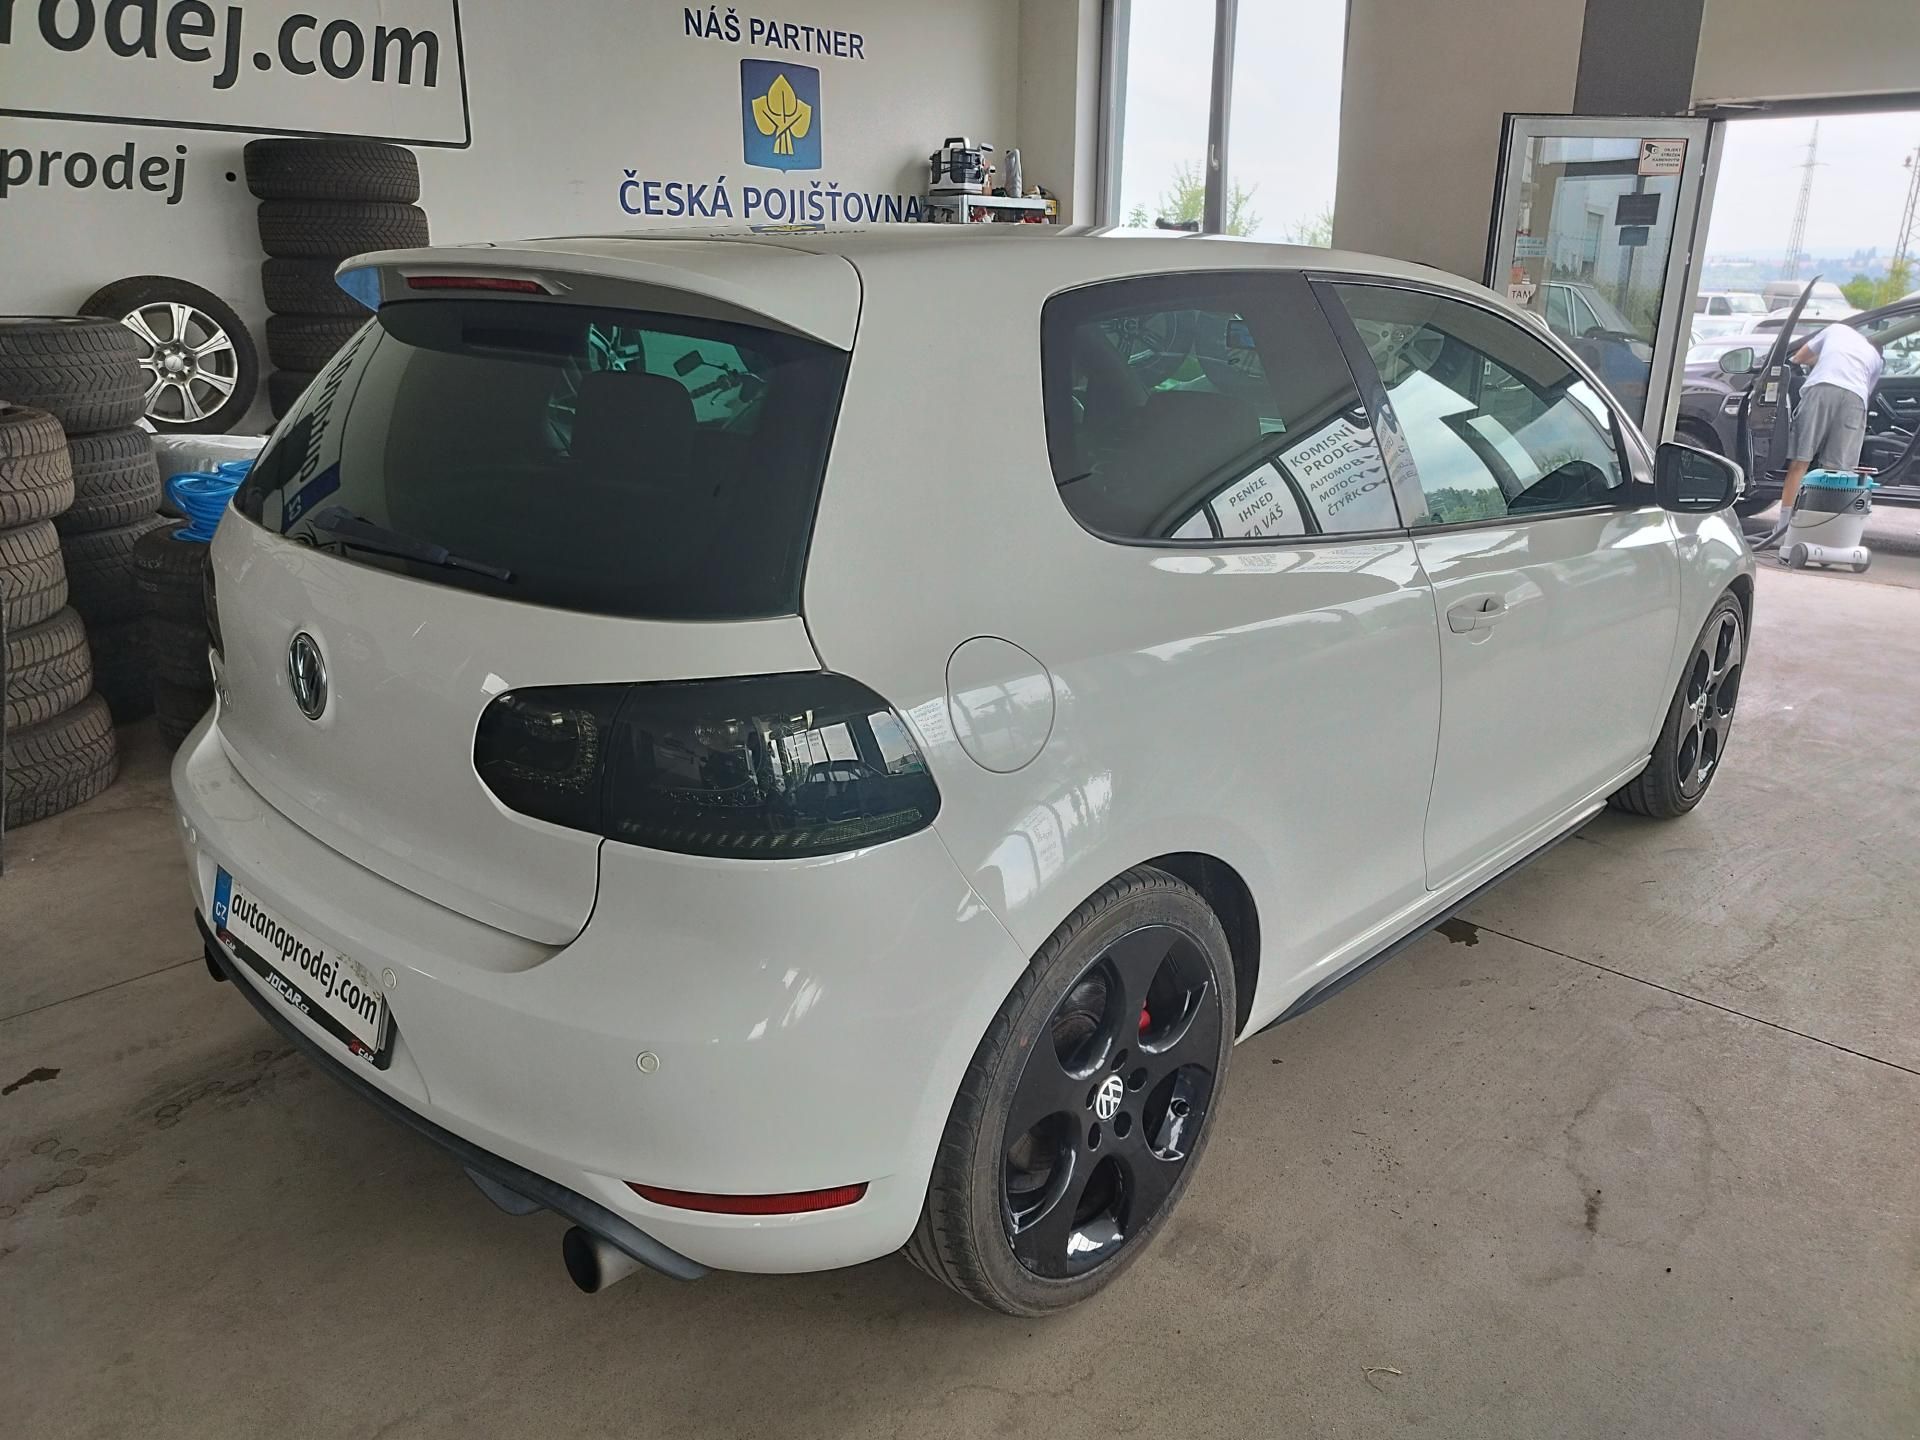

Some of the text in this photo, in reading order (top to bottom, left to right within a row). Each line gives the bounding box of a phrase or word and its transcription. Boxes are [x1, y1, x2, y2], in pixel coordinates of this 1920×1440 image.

[684, 5, 865, 59] NÁŠ PARTNER
[0, 142, 188, 205] prodej
[618, 169, 922, 224] ČESKÁ POJIŠŤOVNA
[1290, 424, 1355, 468] KOMISNÍ
[1303, 438, 1377, 476] PRODE
[1229, 477, 1267, 507] PENÍZE
[1239, 492, 1273, 522] IHNED
[1262, 502, 1284, 528] VÁŠ
[215, 902, 227, 921] CZ
[231, 894, 378, 1025] autanaprodej.com
